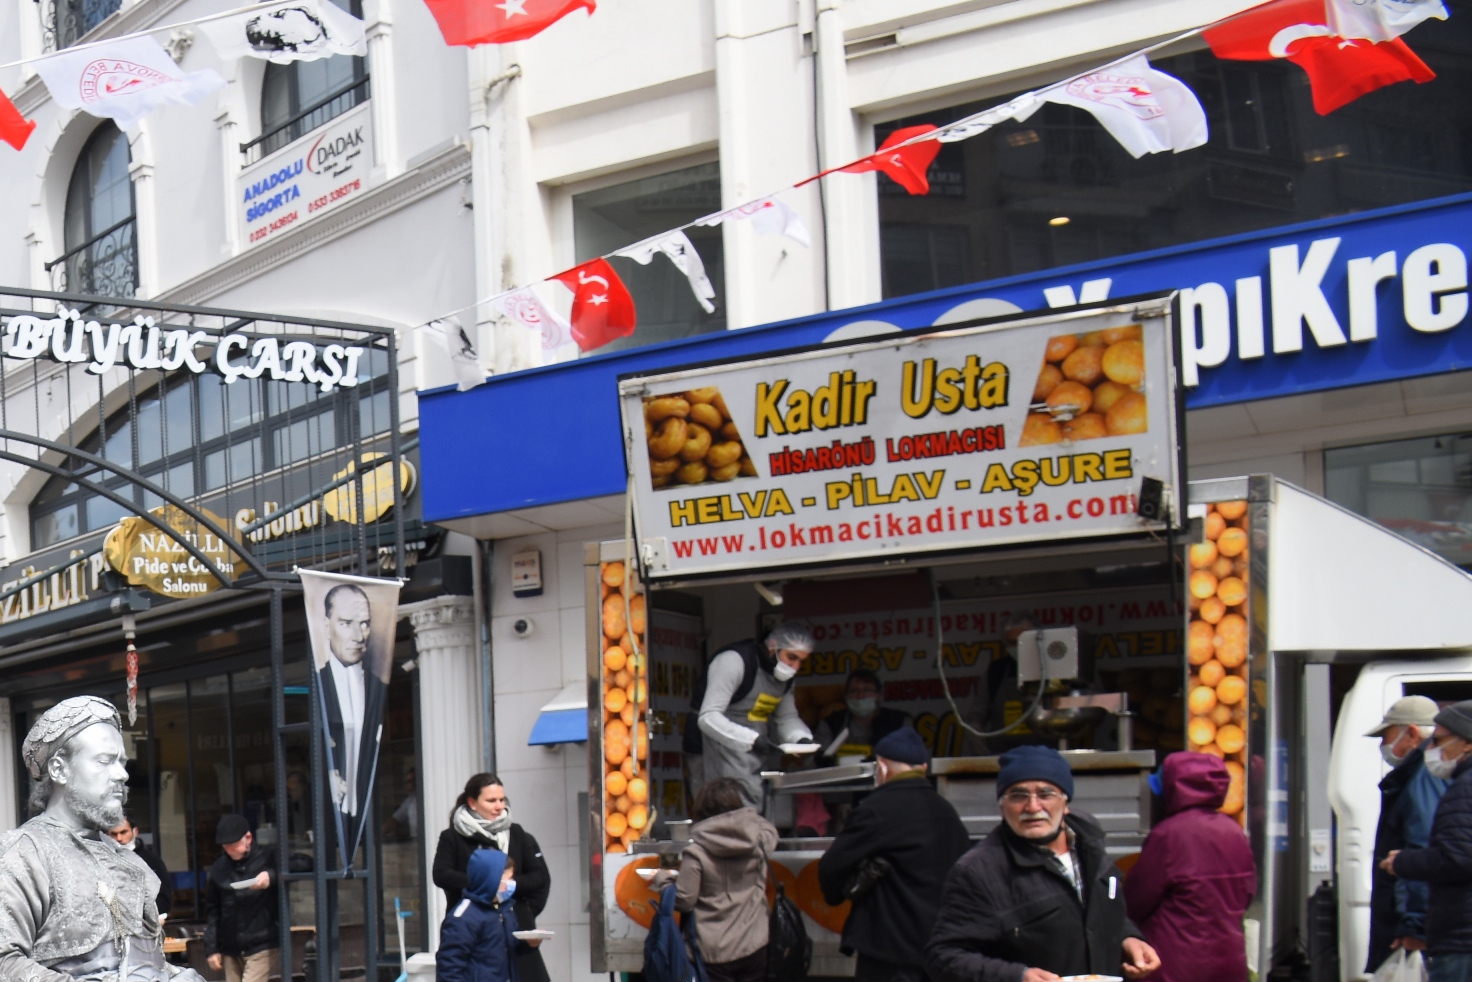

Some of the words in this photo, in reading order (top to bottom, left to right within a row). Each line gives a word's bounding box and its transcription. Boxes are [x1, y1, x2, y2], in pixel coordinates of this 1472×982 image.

[316, 126, 364, 166] DADAK
[243, 158, 304, 203] ANADOLU
[246, 184, 301, 222] SİGORTA
[6, 308, 206, 374] BÜYÜK
[216, 334, 364, 392] ÇARŞI
[753, 369, 876, 439] Kadir
[900, 355, 1010, 420] Usta
[769, 441, 876, 477] HİSARÖNÜ
[887, 424, 1006, 462] LOKMACISI
[669, 486, 792, 528] HELVA
[828, 469, 945, 511] PİLAV
[981, 449, 1133, 496] AŞURE
[673, 492, 1140, 559] www.lokmacikadirusta.com
[133, 556, 169, 575] Pide
[172, 562, 187, 574] ve
[163, 578, 208, 593] Salonu
